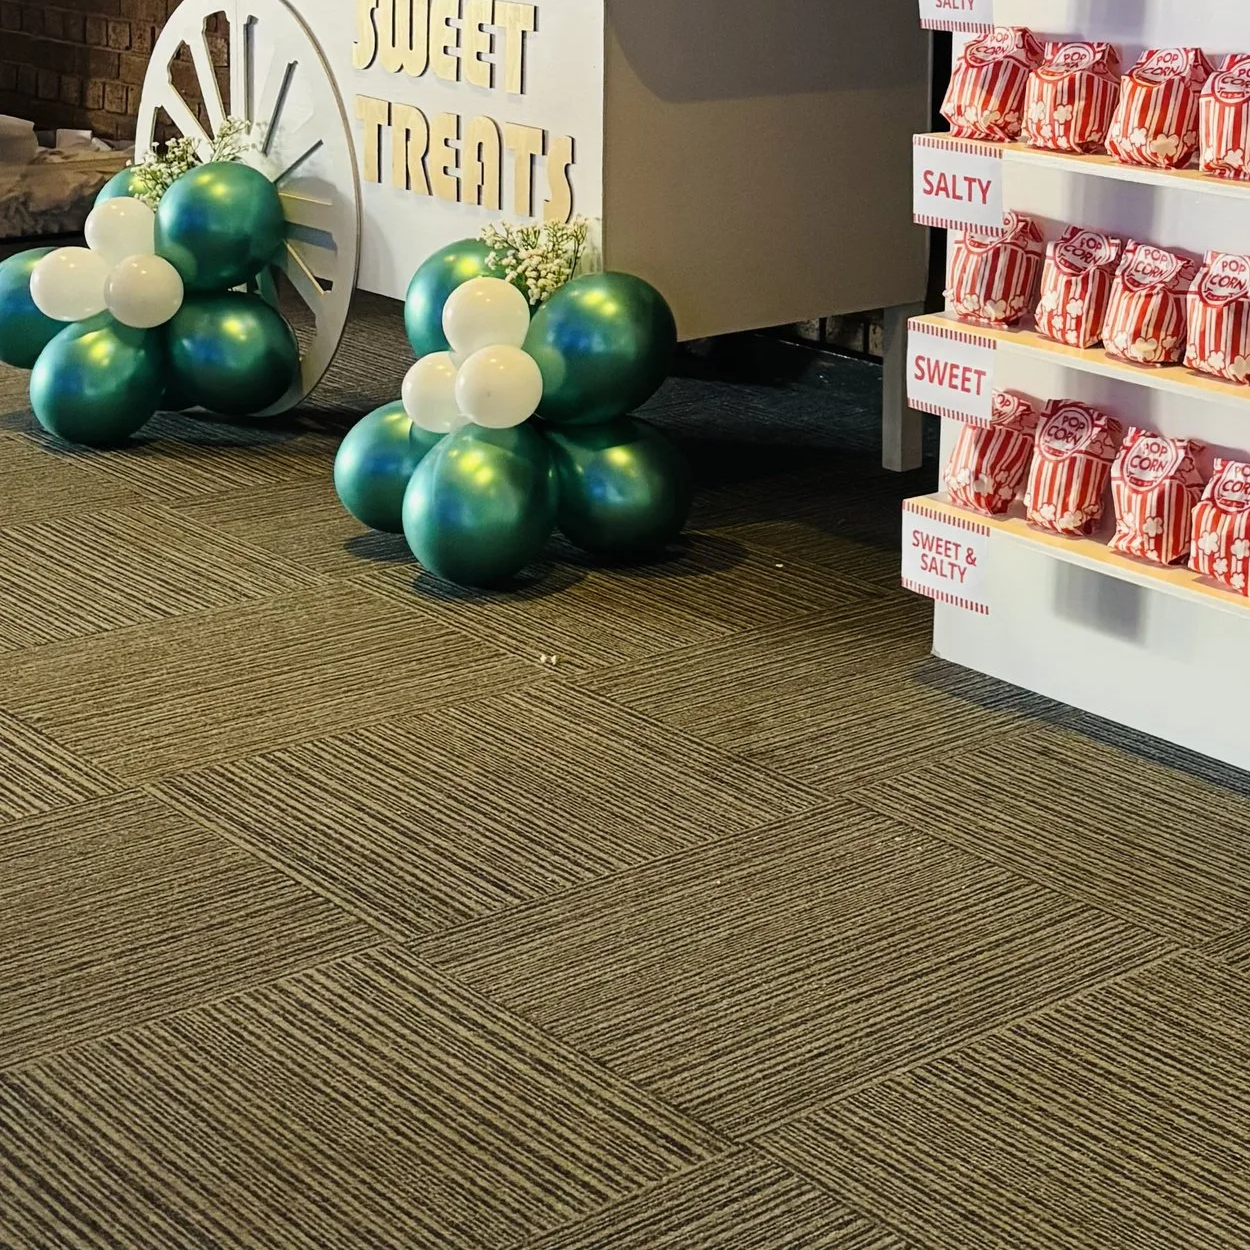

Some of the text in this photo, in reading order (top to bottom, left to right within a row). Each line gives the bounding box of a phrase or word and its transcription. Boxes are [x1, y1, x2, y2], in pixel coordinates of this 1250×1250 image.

[989, 33, 1009, 43] POP
[1064, 52, 1086, 62] POP
[1156, 52, 1179, 65] POP
[1142, 66, 1180, 76] CORN
[354, 93, 577, 227] TREATS
[923, 170, 992, 205] SALTY
[1064, 245, 1100, 264] CORN
[1144, 249, 1168, 262] POP
[1133, 260, 1164, 278] CORN
[1222, 259, 1246, 273] POP
[1209, 275, 1245, 290] CORN
[914, 354, 987, 396] SWEET
[995, 394, 1011, 408] OP
[1062, 416, 1085, 430] POP
[1047, 426, 1080, 444] CORN
[1130, 455, 1166, 471] CORN
[912, 530, 977, 566] SWEET &
[920, 553, 967, 584] SALTY
